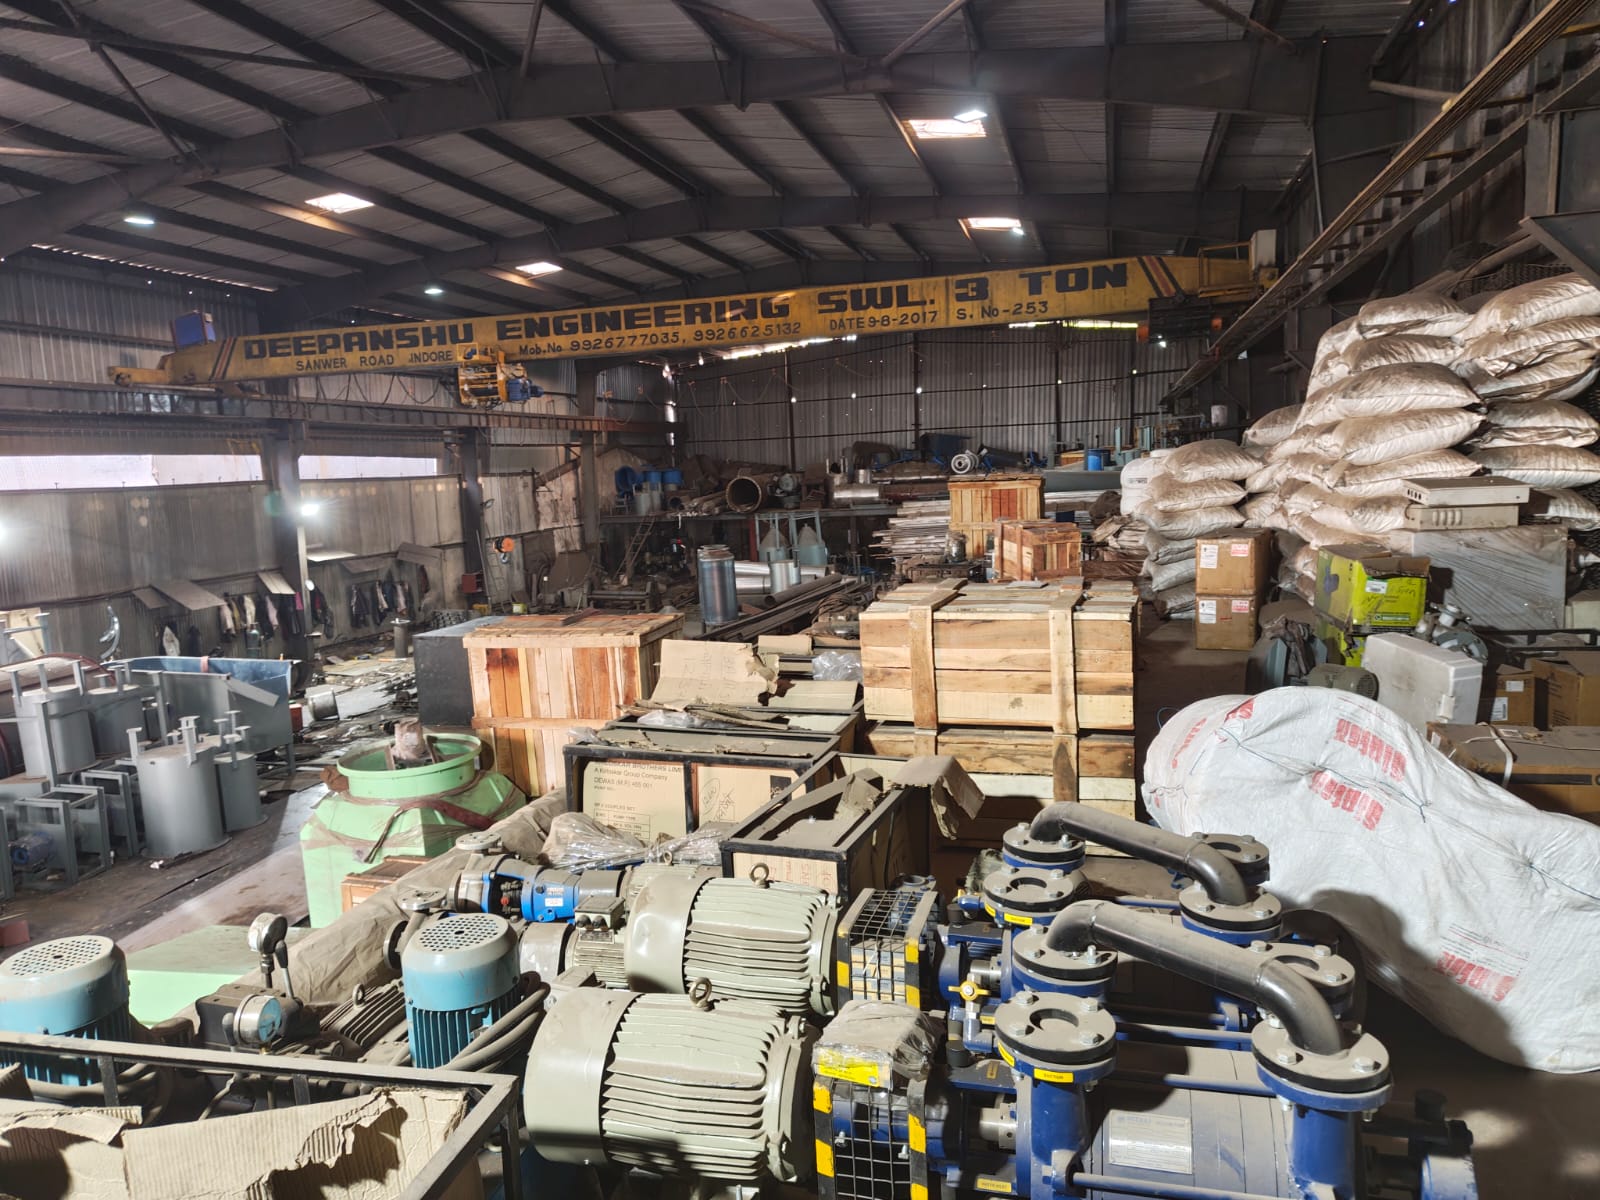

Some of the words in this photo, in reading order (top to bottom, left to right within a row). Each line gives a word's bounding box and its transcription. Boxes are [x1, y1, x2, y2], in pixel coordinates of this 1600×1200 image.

[244, 323, 474, 360] DEEPANSHU
[496, 298, 790, 340] ENGINEERING
[817, 284, 936, 314] SWL.
[955, 277, 989, 302] 3
[1019, 263, 1128, 296] TON
[693, 322, 801, 342] 9926625132
[829, 316, 865, 331] DATE
[296, 357, 347, 371] SANWER
[359, 354, 394, 367] ROAD
[409, 351, 453, 364] INDORE
[641, 772, 668, 781] Company
